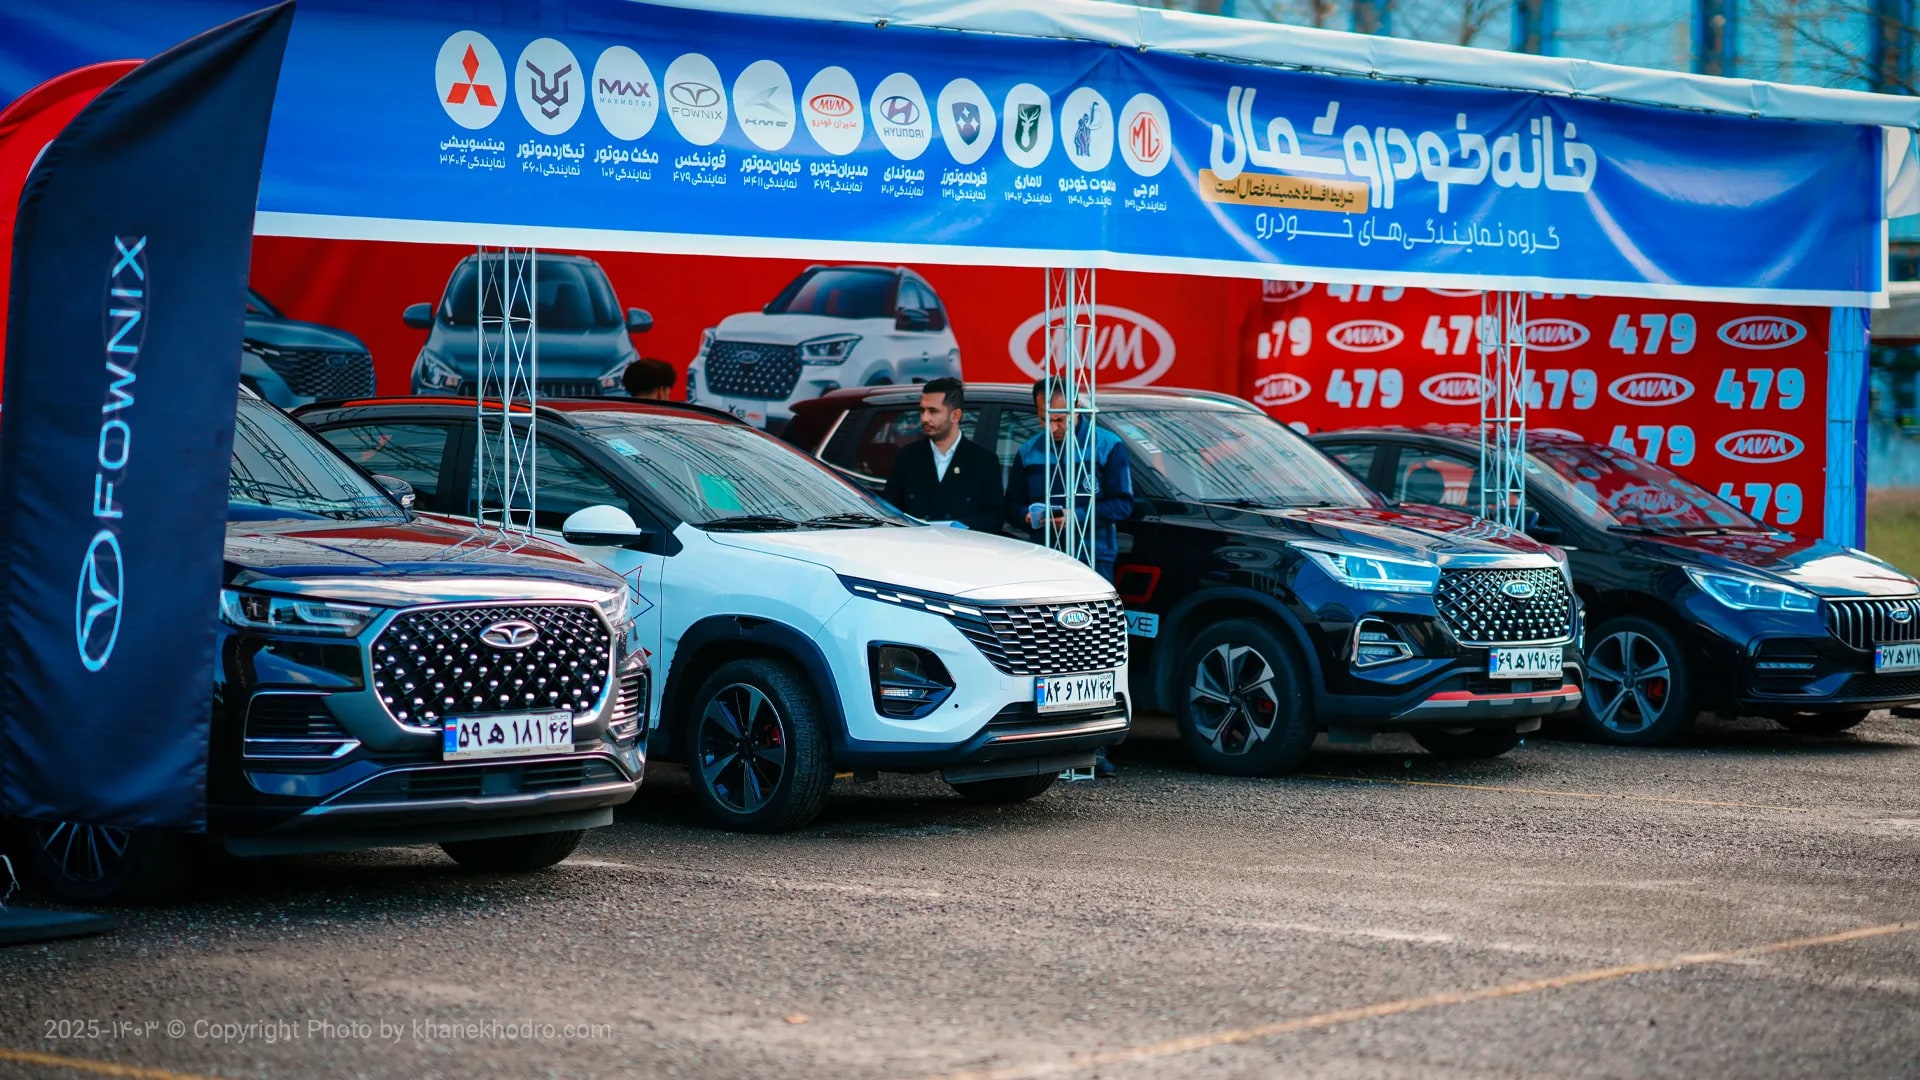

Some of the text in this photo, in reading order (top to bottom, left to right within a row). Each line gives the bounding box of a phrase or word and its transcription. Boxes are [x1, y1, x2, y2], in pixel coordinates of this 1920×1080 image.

[599, 79, 651, 98] MAX
[672, 107, 723, 120] FOWNIX
[818, 99, 846, 111] MVM
[883, 127, 925, 139] HYUNDAI
[1133, 117, 1160, 157] MG
[440, 135, 505, 154] میتسوبیشی
[1492, 114, 1597, 193] خانه
[467, 156, 506, 171] نمایندگی
[594, 145, 659, 164] مکث موتور
[675, 149, 726, 171] فونیکس
[543, 163, 580, 178] نمایندگی
[615, 168, 652, 182] نمایندگی
[692, 172, 727, 187] نمایندگی
[883, 165, 925, 185] هیوندای
[763, 176, 798, 191] نمایندگی
[830, 181, 863, 194] نمایندگی
[1014, 174, 1042, 190] لاماری
[1058, 175, 1089, 193] خودرو
[1215, 180, 1240, 195] است
[1239, 179, 1265, 199] فعال
[894, 186, 924, 199] نمایندگی
[955, 189, 987, 202] نمایندگی
[1022, 192, 1053, 206] نمایندگی
[1266, 184, 1300, 202] همیشه
[1135, 200, 1167, 213] نمایندگی
[1256, 211, 1353, 241] خودرو
[1508, 226, 1560, 254] گروه
[1342, 328, 1388, 345] MVM
[1421, 315, 1499, 356] 479
[1526, 326, 1575, 343] MVM
[1609, 313, 1697, 355] 479
[1732, 323, 1789, 342] MVM
[94, 235, 147, 519] FOWNIX
[1325, 368, 1404, 409] 479
[1623, 380, 1678, 398] MVM
[1715, 368, 1805, 410] 479
[1608, 425, 1696, 467] 479
[1731, 436, 1787, 455] MVM
[459, 722, 482, 748] ۵۹
[513, 720, 542, 745] ۱۸۱
